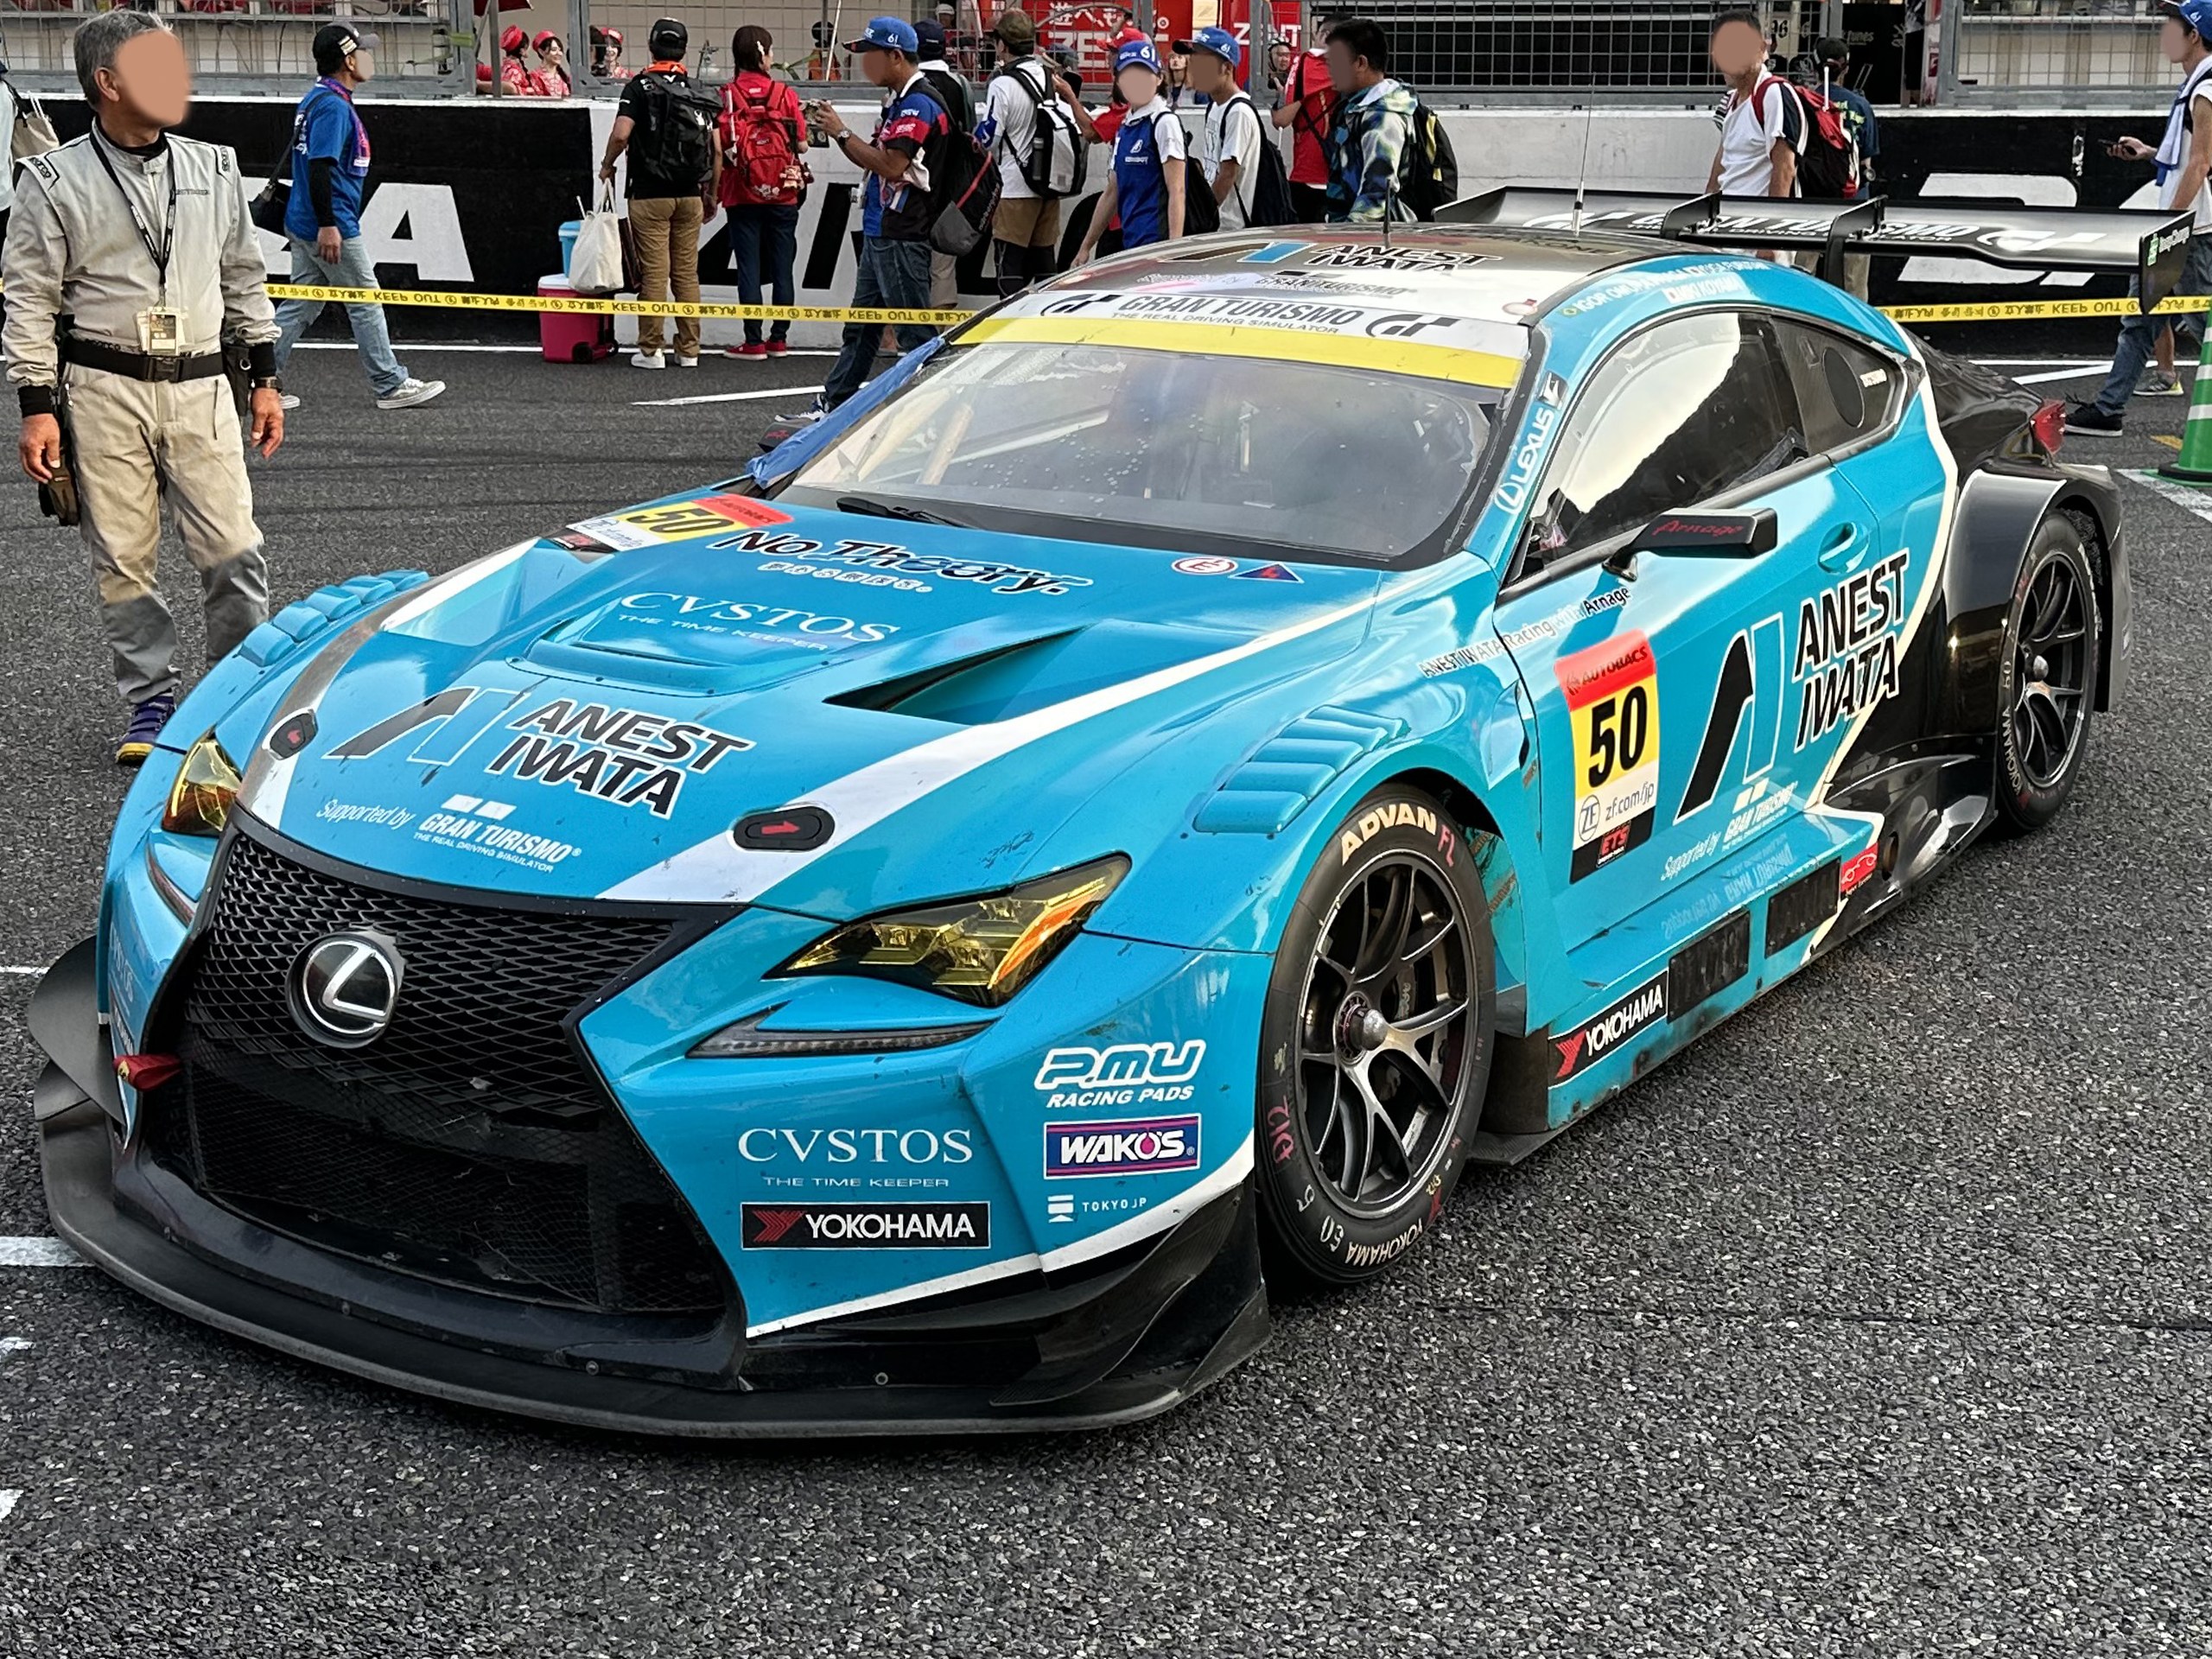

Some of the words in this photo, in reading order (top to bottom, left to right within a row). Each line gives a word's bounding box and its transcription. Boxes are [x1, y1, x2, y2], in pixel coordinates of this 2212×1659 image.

[887, 33, 899, 45] 61
[1140, 46, 1156, 62] 61
[1220, 43, 1231, 53] 61
[1316, 243, 1502, 267] ANEST
[1120, 295, 1215, 316] GRAN
[1220, 299, 1364, 326] TURISMO
[1576, 290, 1611, 313] IGOR
[1112, 311, 1144, 320] THE
[1145, 313, 1185, 323] REAL
[1187, 315, 1242, 327] DRIVING
[1247, 320, 1340, 335] SIMULATOR
[1510, 407, 1555, 485] LEXUS
[626, 507, 734, 533] 50
[712, 531, 819, 556] No
[619, 614, 664, 625] THE
[671, 620, 728, 633] TIME
[731, 629, 829, 652] KEEPER
[620, 593, 900, 642] CVSTOS
[1418, 648, 1459, 677] ANEST
[1458, 637, 1502, 666] IWATA
[1503, 620, 1556, 649] Racing
[1555, 603, 1585, 631] with
[1583, 586, 1632, 619] Arnage
[1793, 550, 1910, 681] ANEST
[1795, 632, 1899, 753] IWATA
[512, 698, 752, 772] ANEST
[1587, 685, 1649, 789] 50
[489, 734, 684, 817] IWATA
[316, 798, 388, 827] Supported
[387, 804, 415, 832] by
[1605, 781, 1656, 823] zf.com/jp
[414, 830, 431, 842] THE
[432, 832, 455, 847] REAL
[456, 838, 495, 857] DRIVING
[496, 849, 556, 874] SIMULATOR
[417, 811, 476, 841] GRAN
[477, 825, 575, 864] TURISMO
[1343, 803, 1438, 867] ADVAN
[1586, 984, 1663, 1057] YOKOHAMA
[1046, 1090, 1133, 1108] RACING
[1137, 1085, 1194, 1103] PADS
[737, 1128, 974, 1164] CVSTOS
[763, 1176, 804, 1187] THE
[811, 1177, 861, 1187] TIME
[869, 1178, 950, 1188] KEEPER
[1083, 1198, 1129, 1212] TOKYO
[1130, 1197, 1147, 1210] JP
[804, 1212, 976, 1239] YOKOHAMA
[1344, 1217, 1424, 1267] YOKOHAMA
